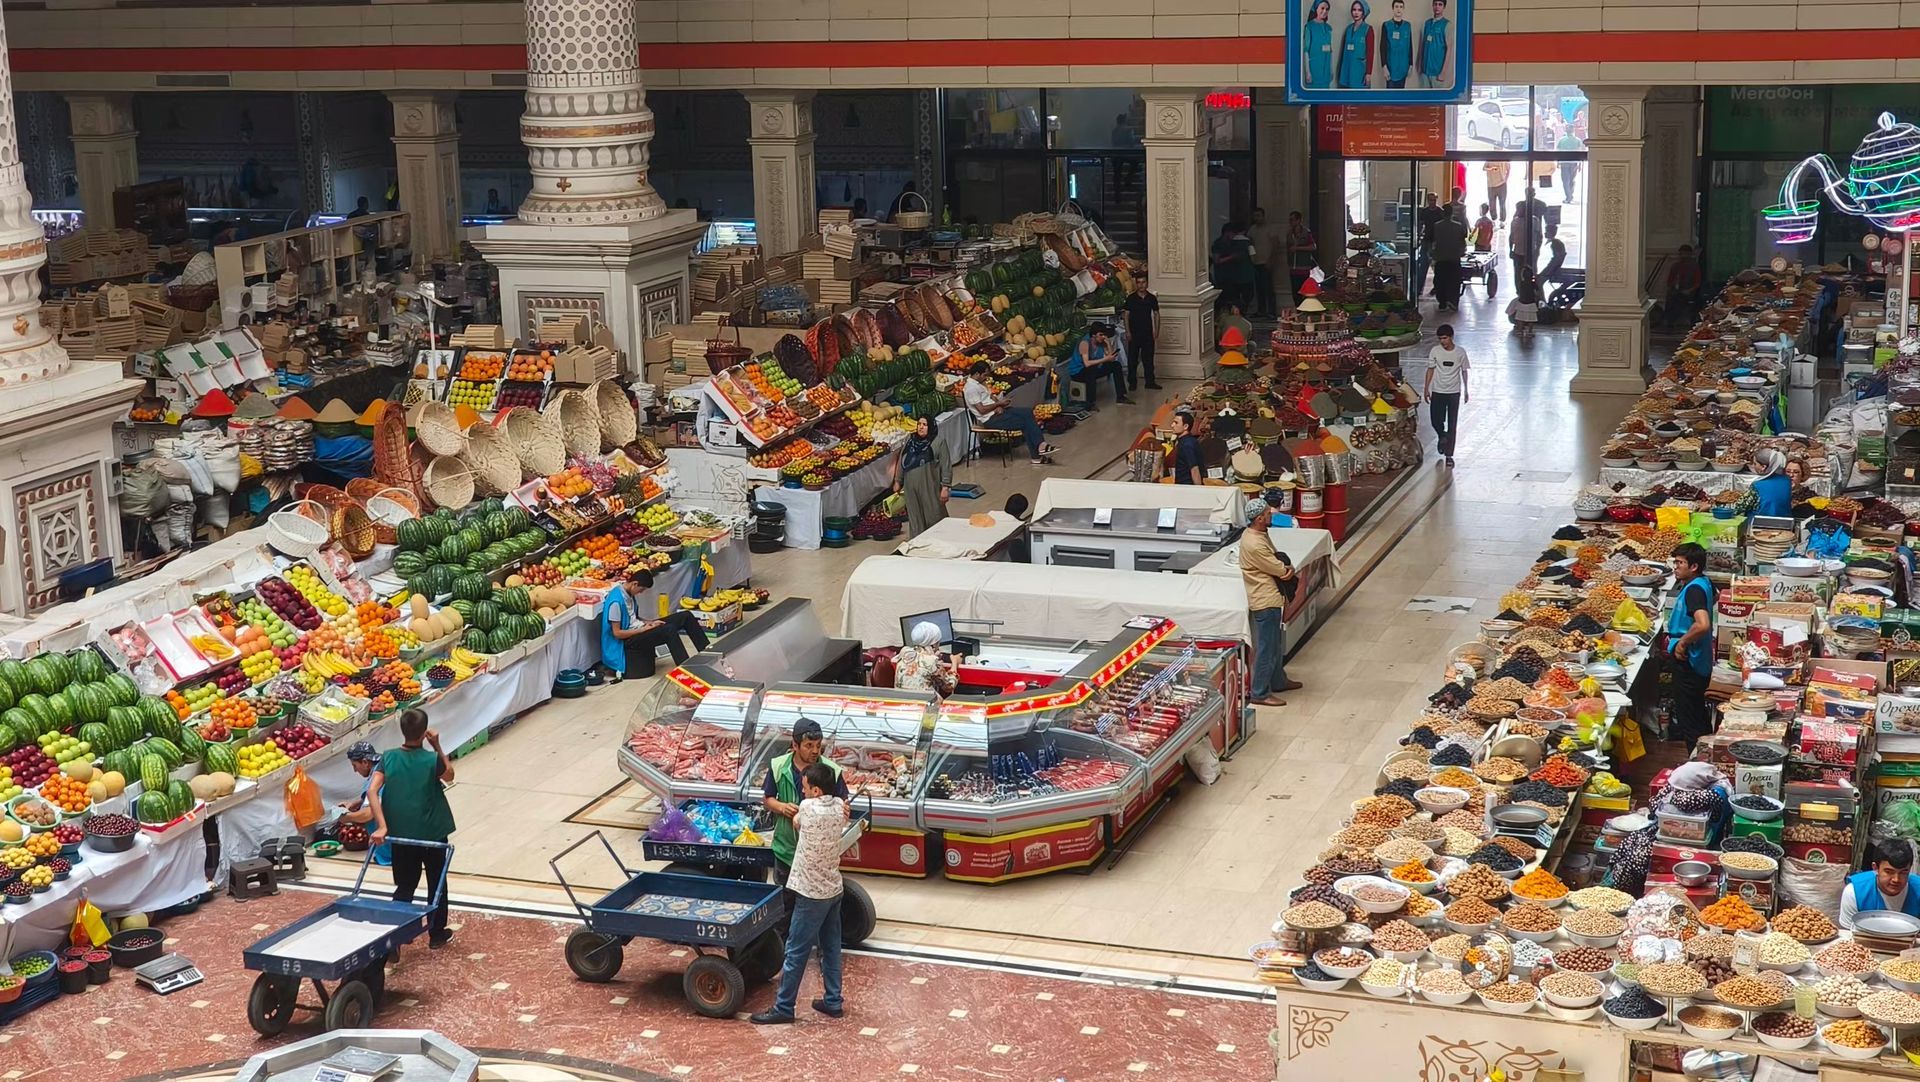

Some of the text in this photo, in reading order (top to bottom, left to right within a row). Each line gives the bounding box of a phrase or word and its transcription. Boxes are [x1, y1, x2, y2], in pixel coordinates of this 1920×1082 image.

[1731, 86, 1814, 100] МегаФон
[1704, 551, 1728, 559] рехи
[1773, 582, 1809, 596] Орехи
[1742, 771, 1772, 785] Орехи
[696, 923, 728, 939] 020
